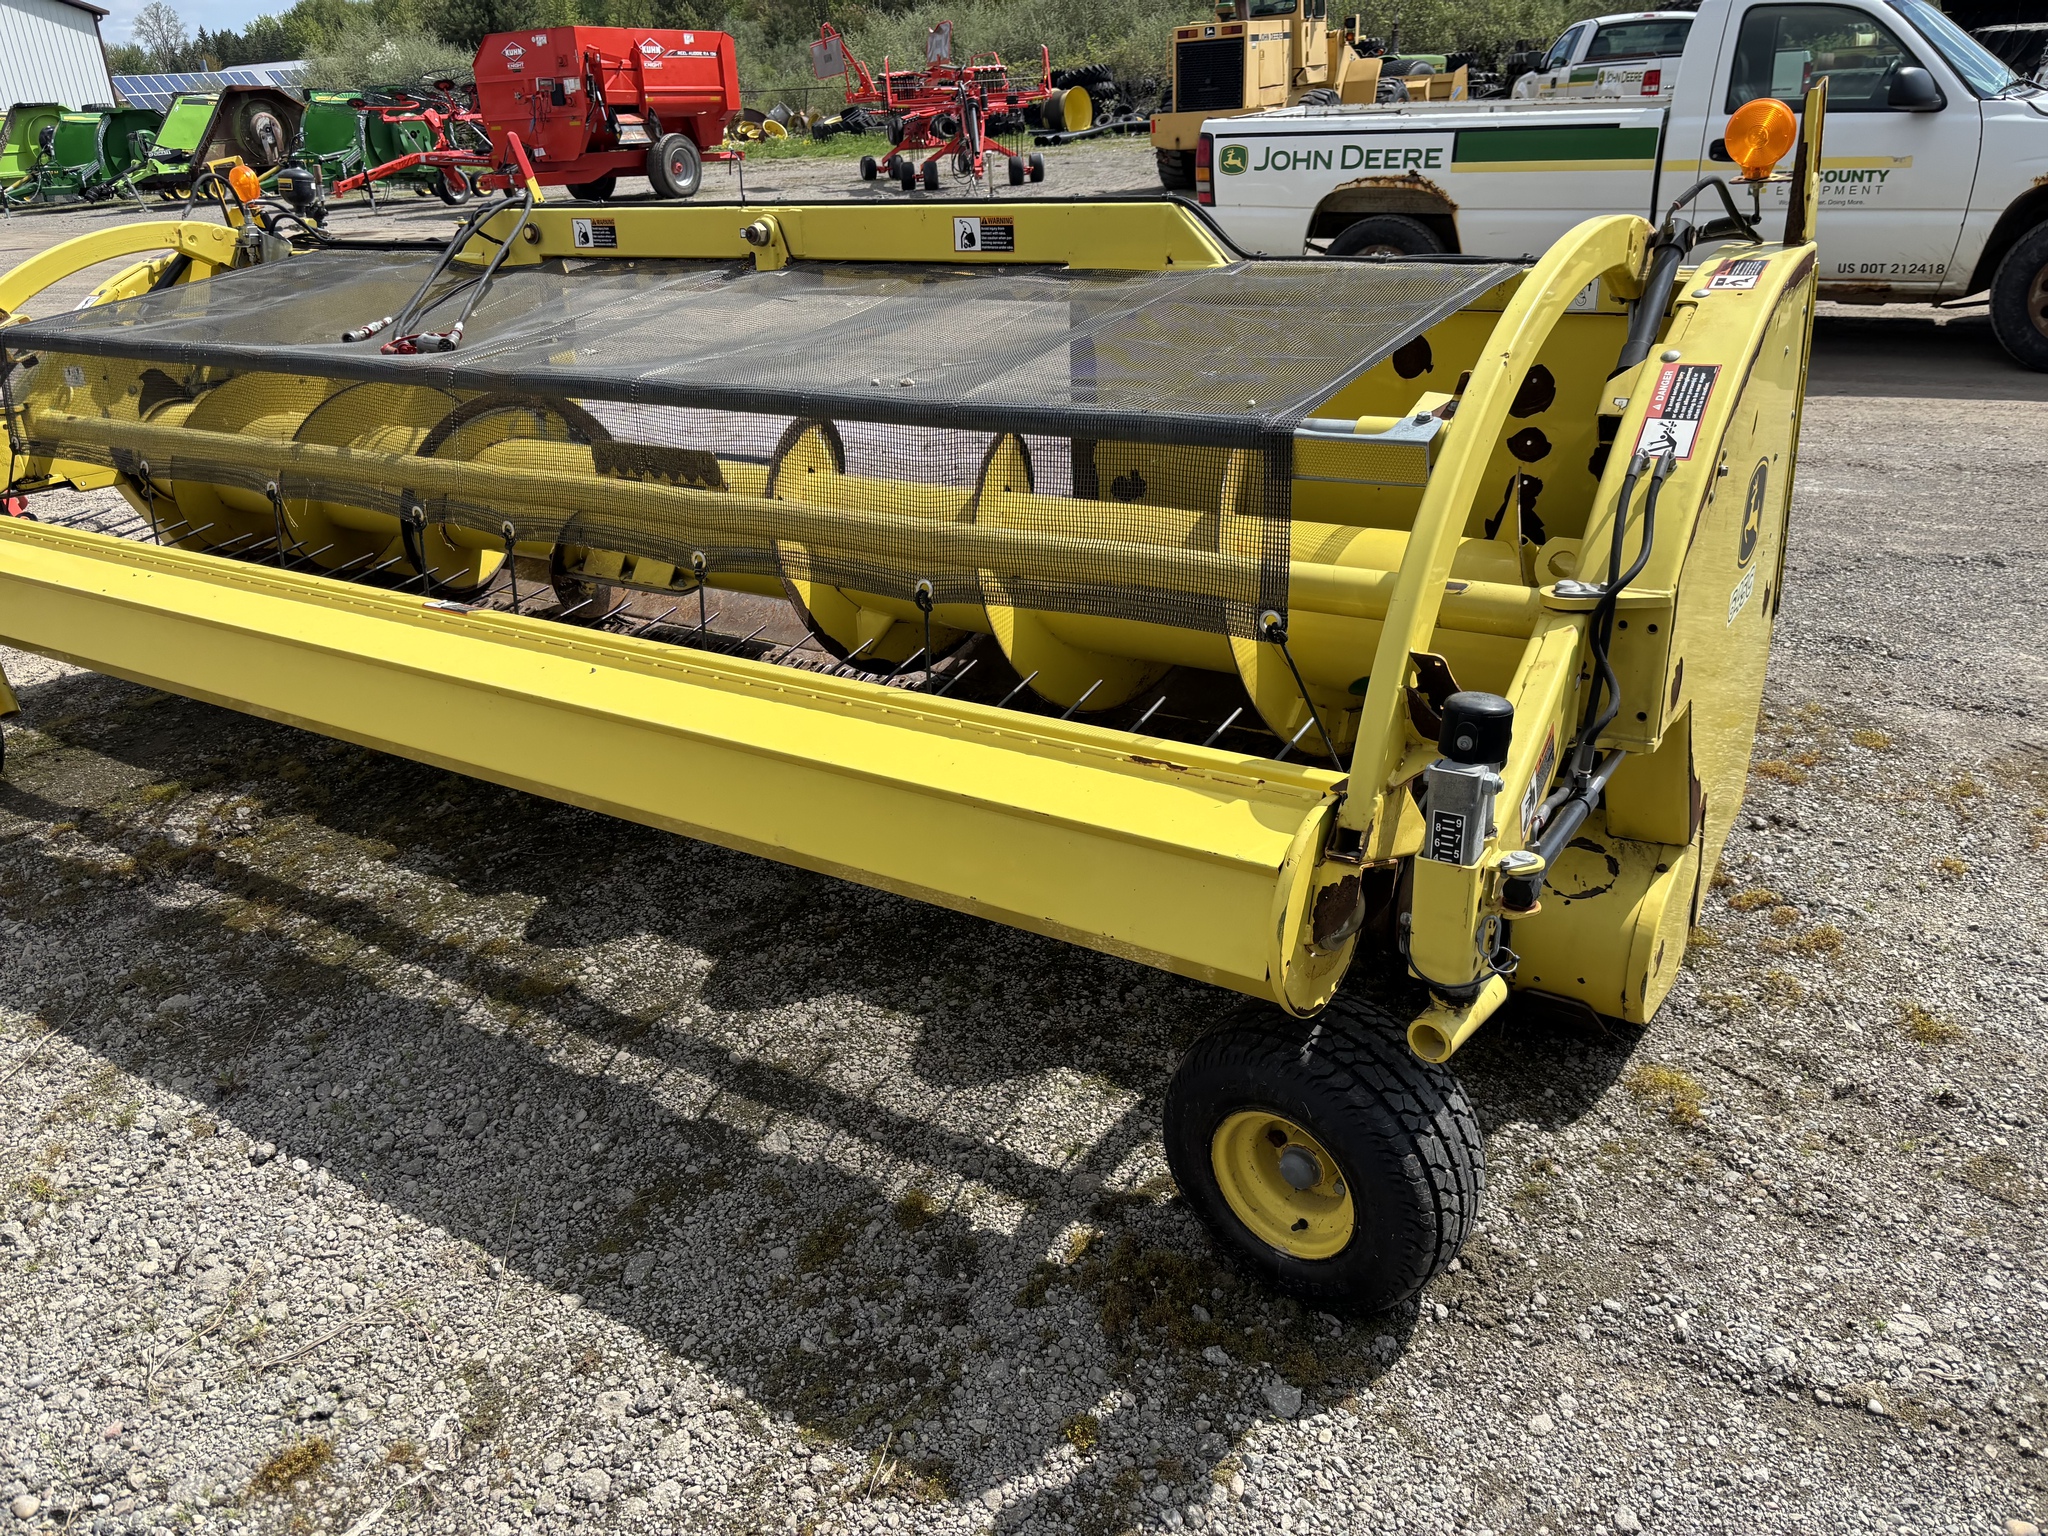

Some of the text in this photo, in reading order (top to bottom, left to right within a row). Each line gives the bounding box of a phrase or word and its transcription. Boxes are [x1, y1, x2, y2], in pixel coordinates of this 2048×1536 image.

[505, 48, 522, 56] KUHN
[642, 46, 661, 54] KUHN
[1604, 70, 1643, 83] JOHN DEERE
[1254, 145, 1443, 171] JOHN DEERE
[1828, 199, 1846, 207] Doing
[1837, 263, 1945, 274] US DOT 212418
[1655, 370, 1674, 401] DANGER
[1435, 823, 1441, 832] 8
[1456, 819, 1462, 828] 9
[1434, 838, 1440, 847] 6
[1455, 834, 1461, 843] 7
[1453, 850, 1459, 859] 5
